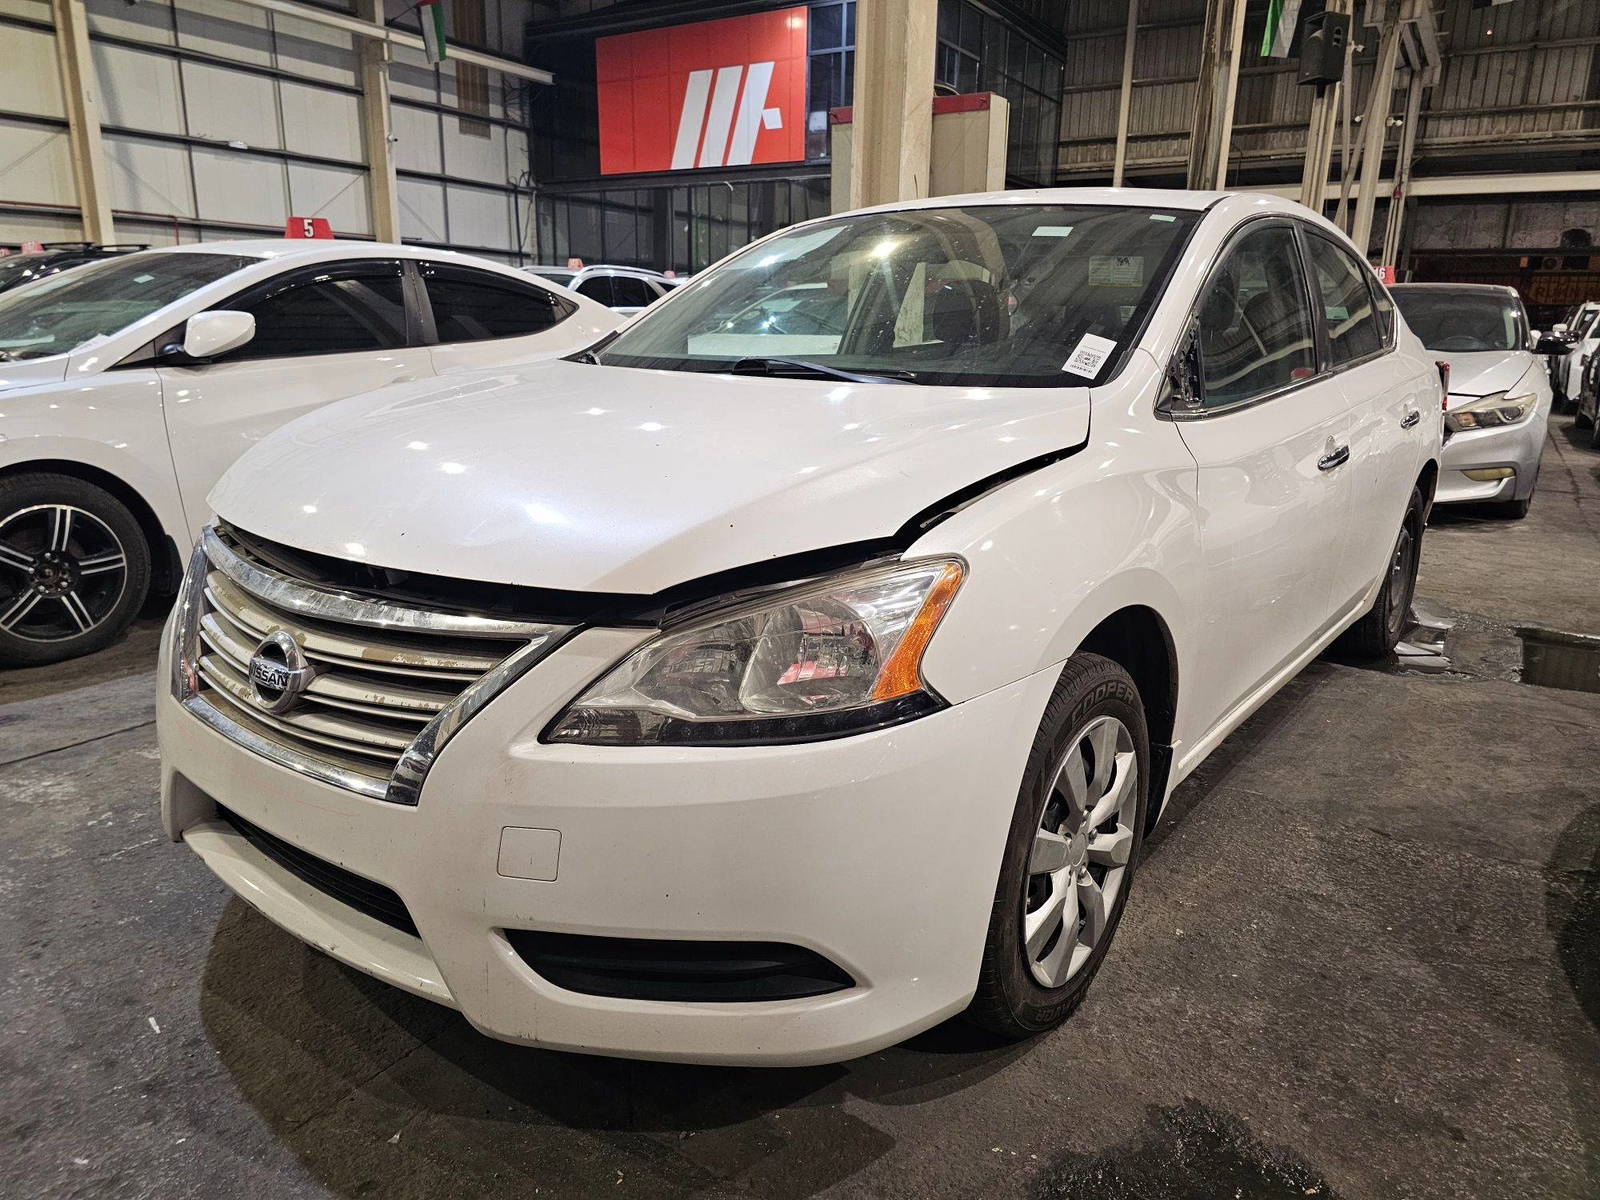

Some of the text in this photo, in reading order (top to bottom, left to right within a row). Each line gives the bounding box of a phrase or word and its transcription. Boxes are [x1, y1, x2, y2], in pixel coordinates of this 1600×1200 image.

[303, 218, 314, 238] 5
[250, 661, 289, 687] NISSAN
[1071, 681, 1135, 724] COOPER
